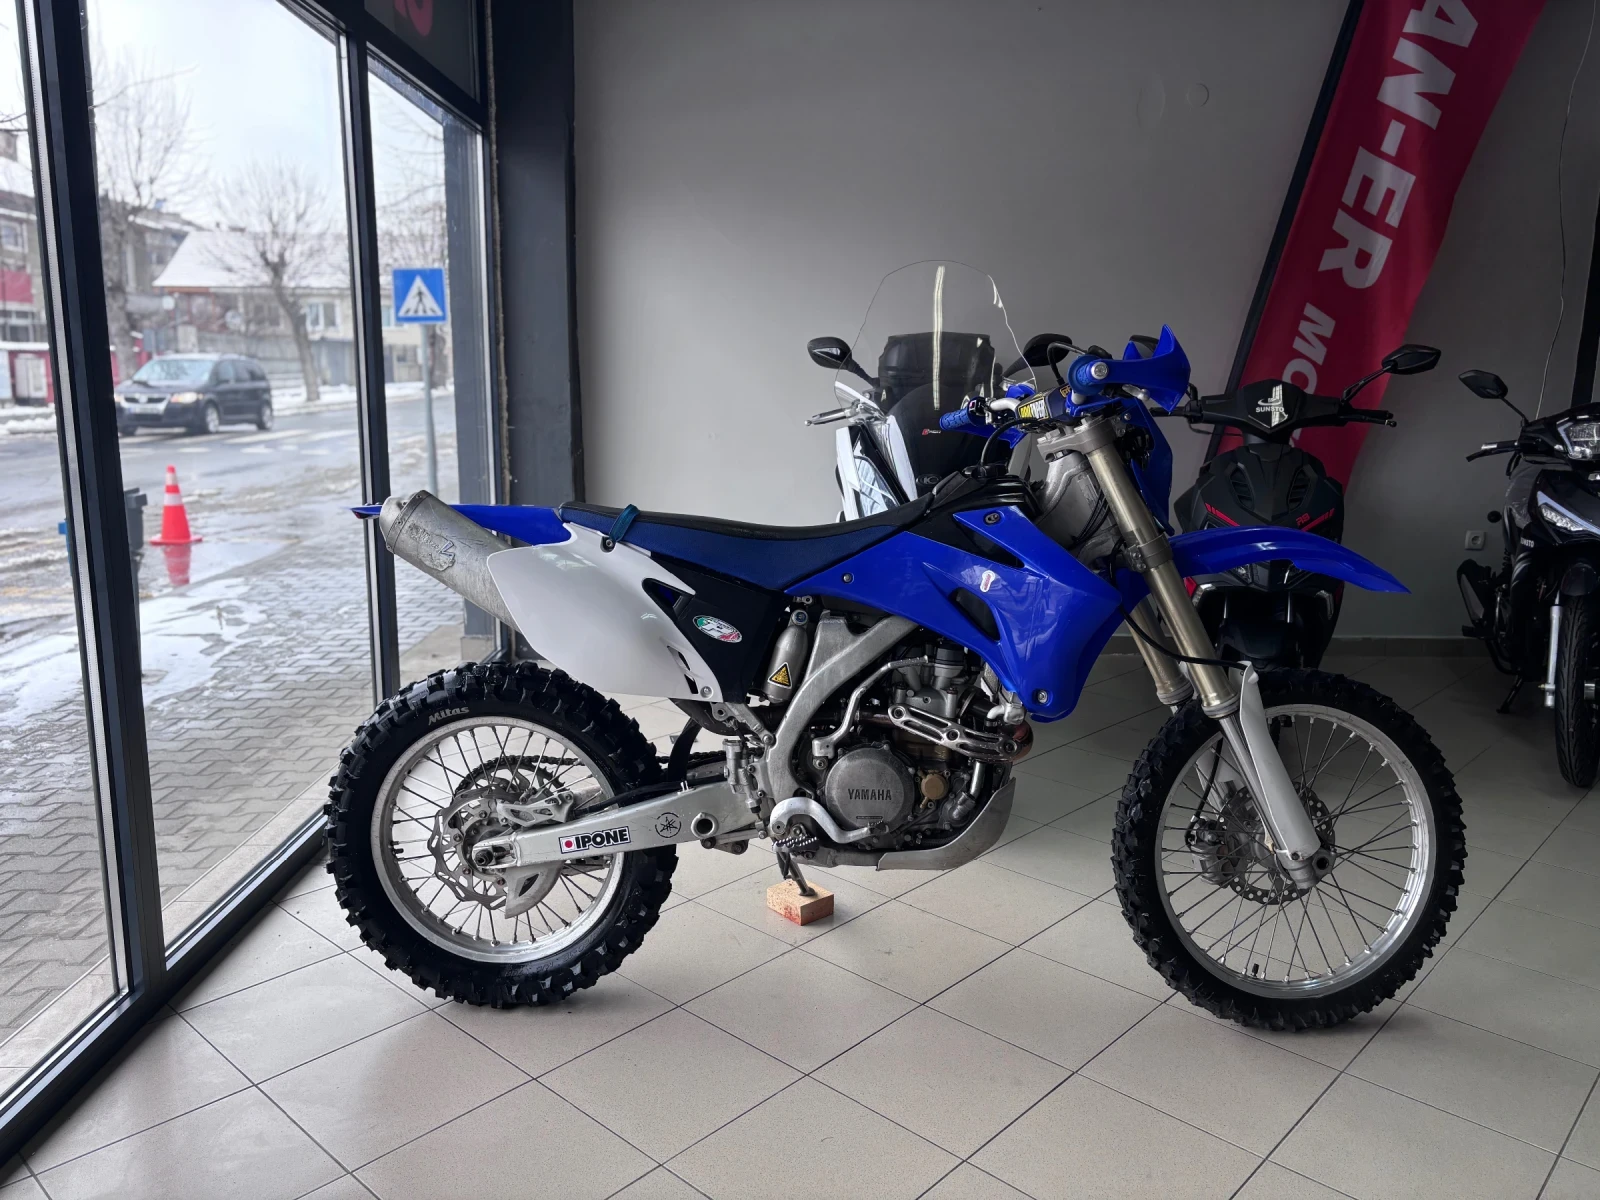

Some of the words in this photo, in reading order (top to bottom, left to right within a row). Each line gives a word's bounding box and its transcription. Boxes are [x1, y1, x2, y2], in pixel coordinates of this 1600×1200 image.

[428, 706, 470, 726] Mitas
[847, 788, 892, 801] YAMAHA
[574, 828, 630, 849] IPONE
